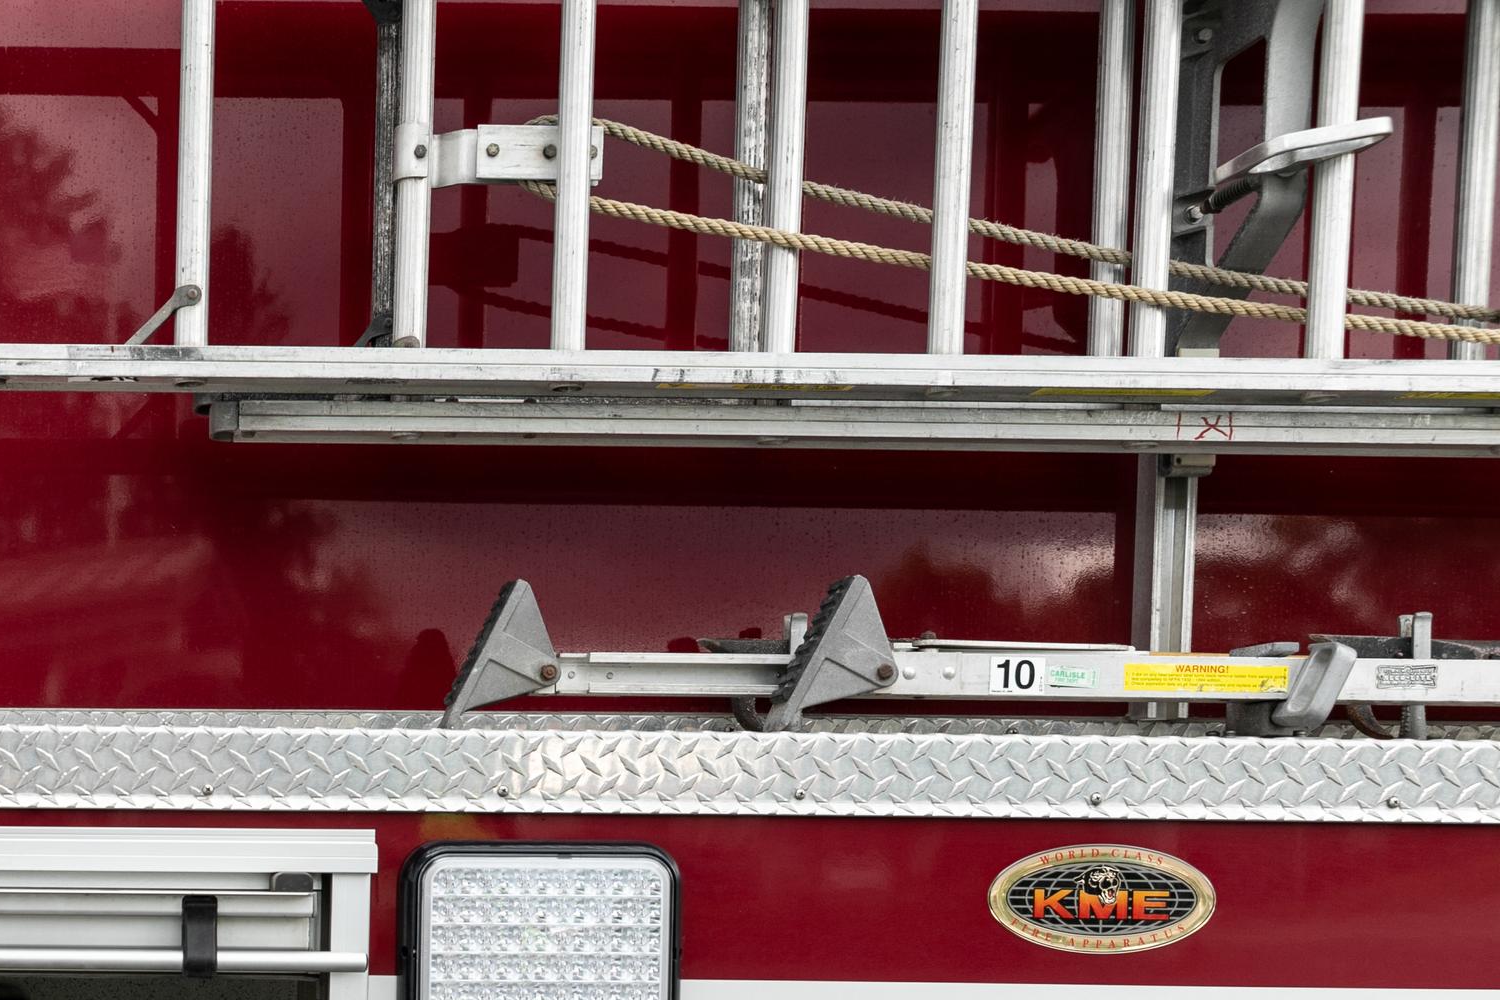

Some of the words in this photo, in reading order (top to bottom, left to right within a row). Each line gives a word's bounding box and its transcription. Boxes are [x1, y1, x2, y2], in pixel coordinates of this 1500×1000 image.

[997, 659, 1035, 689] 10
[1050, 670, 1085, 679] CARLISLE
[1175, 664, 1229, 674] WARNING!
[1039, 848, 1100, 865] WORLD
[1111, 848, 1164, 865] CLASS
[1032, 888, 1171, 921] KME
[1011, 918, 1052, 941] FIRE
[1068, 924, 1186, 949] APPARATUS
